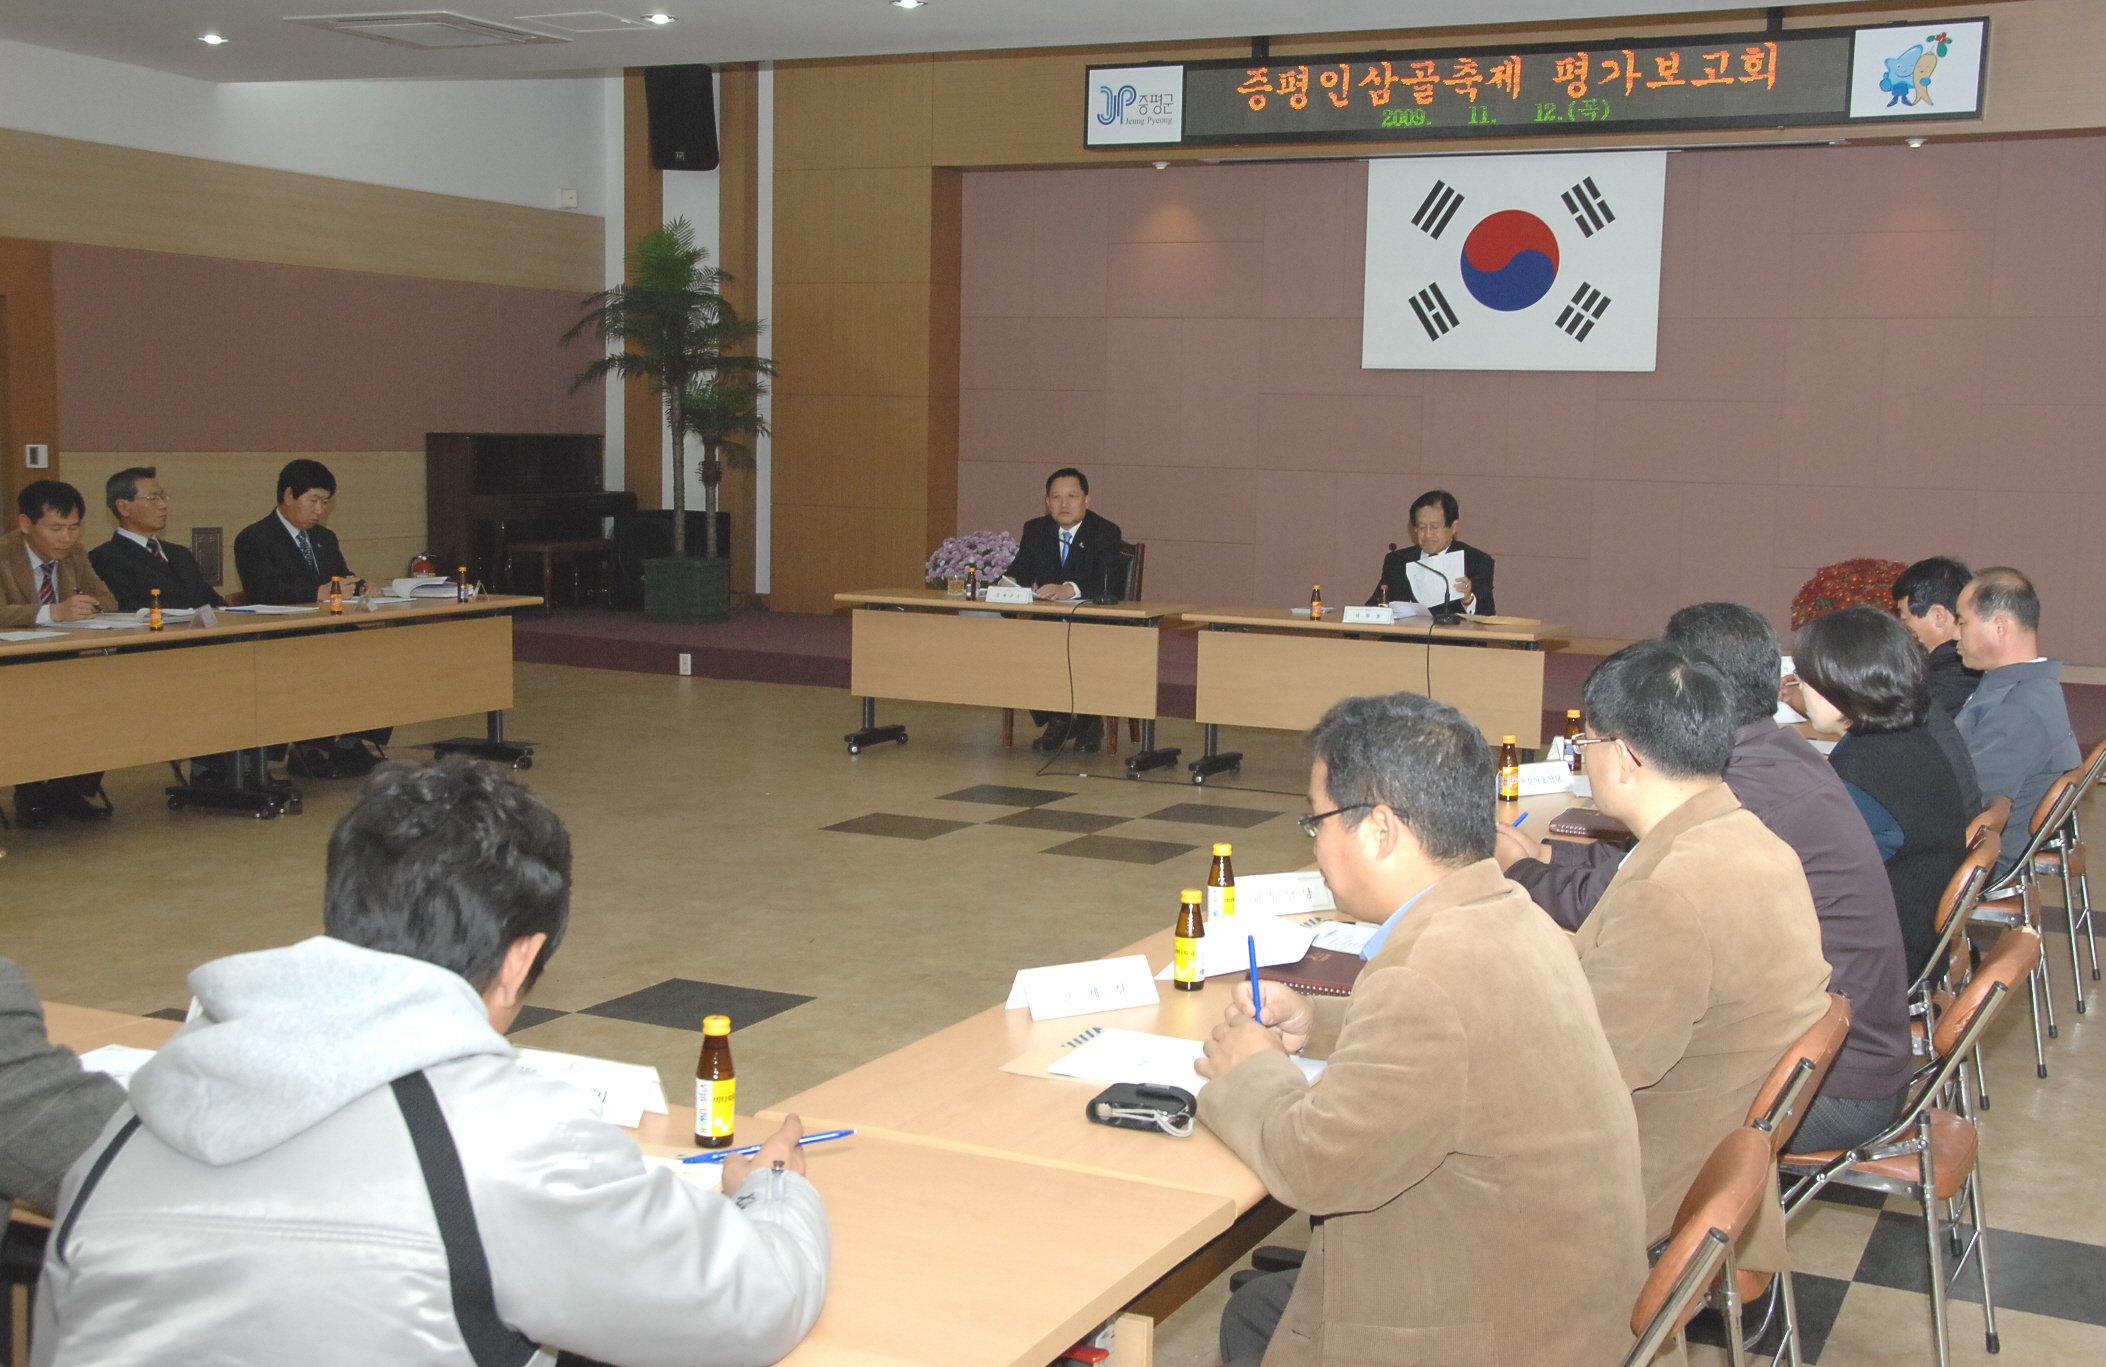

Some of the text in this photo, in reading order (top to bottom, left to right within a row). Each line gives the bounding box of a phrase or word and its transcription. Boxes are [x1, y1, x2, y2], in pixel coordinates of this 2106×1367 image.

[1237, 41, 1779, 111] 증평인삼골축제 평가보고회
[1138, 93, 1174, 116] 증평군
[1125, 116, 1173, 126] Jeung Pyeong
[1381, 108, 1433, 127] 2009.
[1467, 105, 1497, 124] 11.
